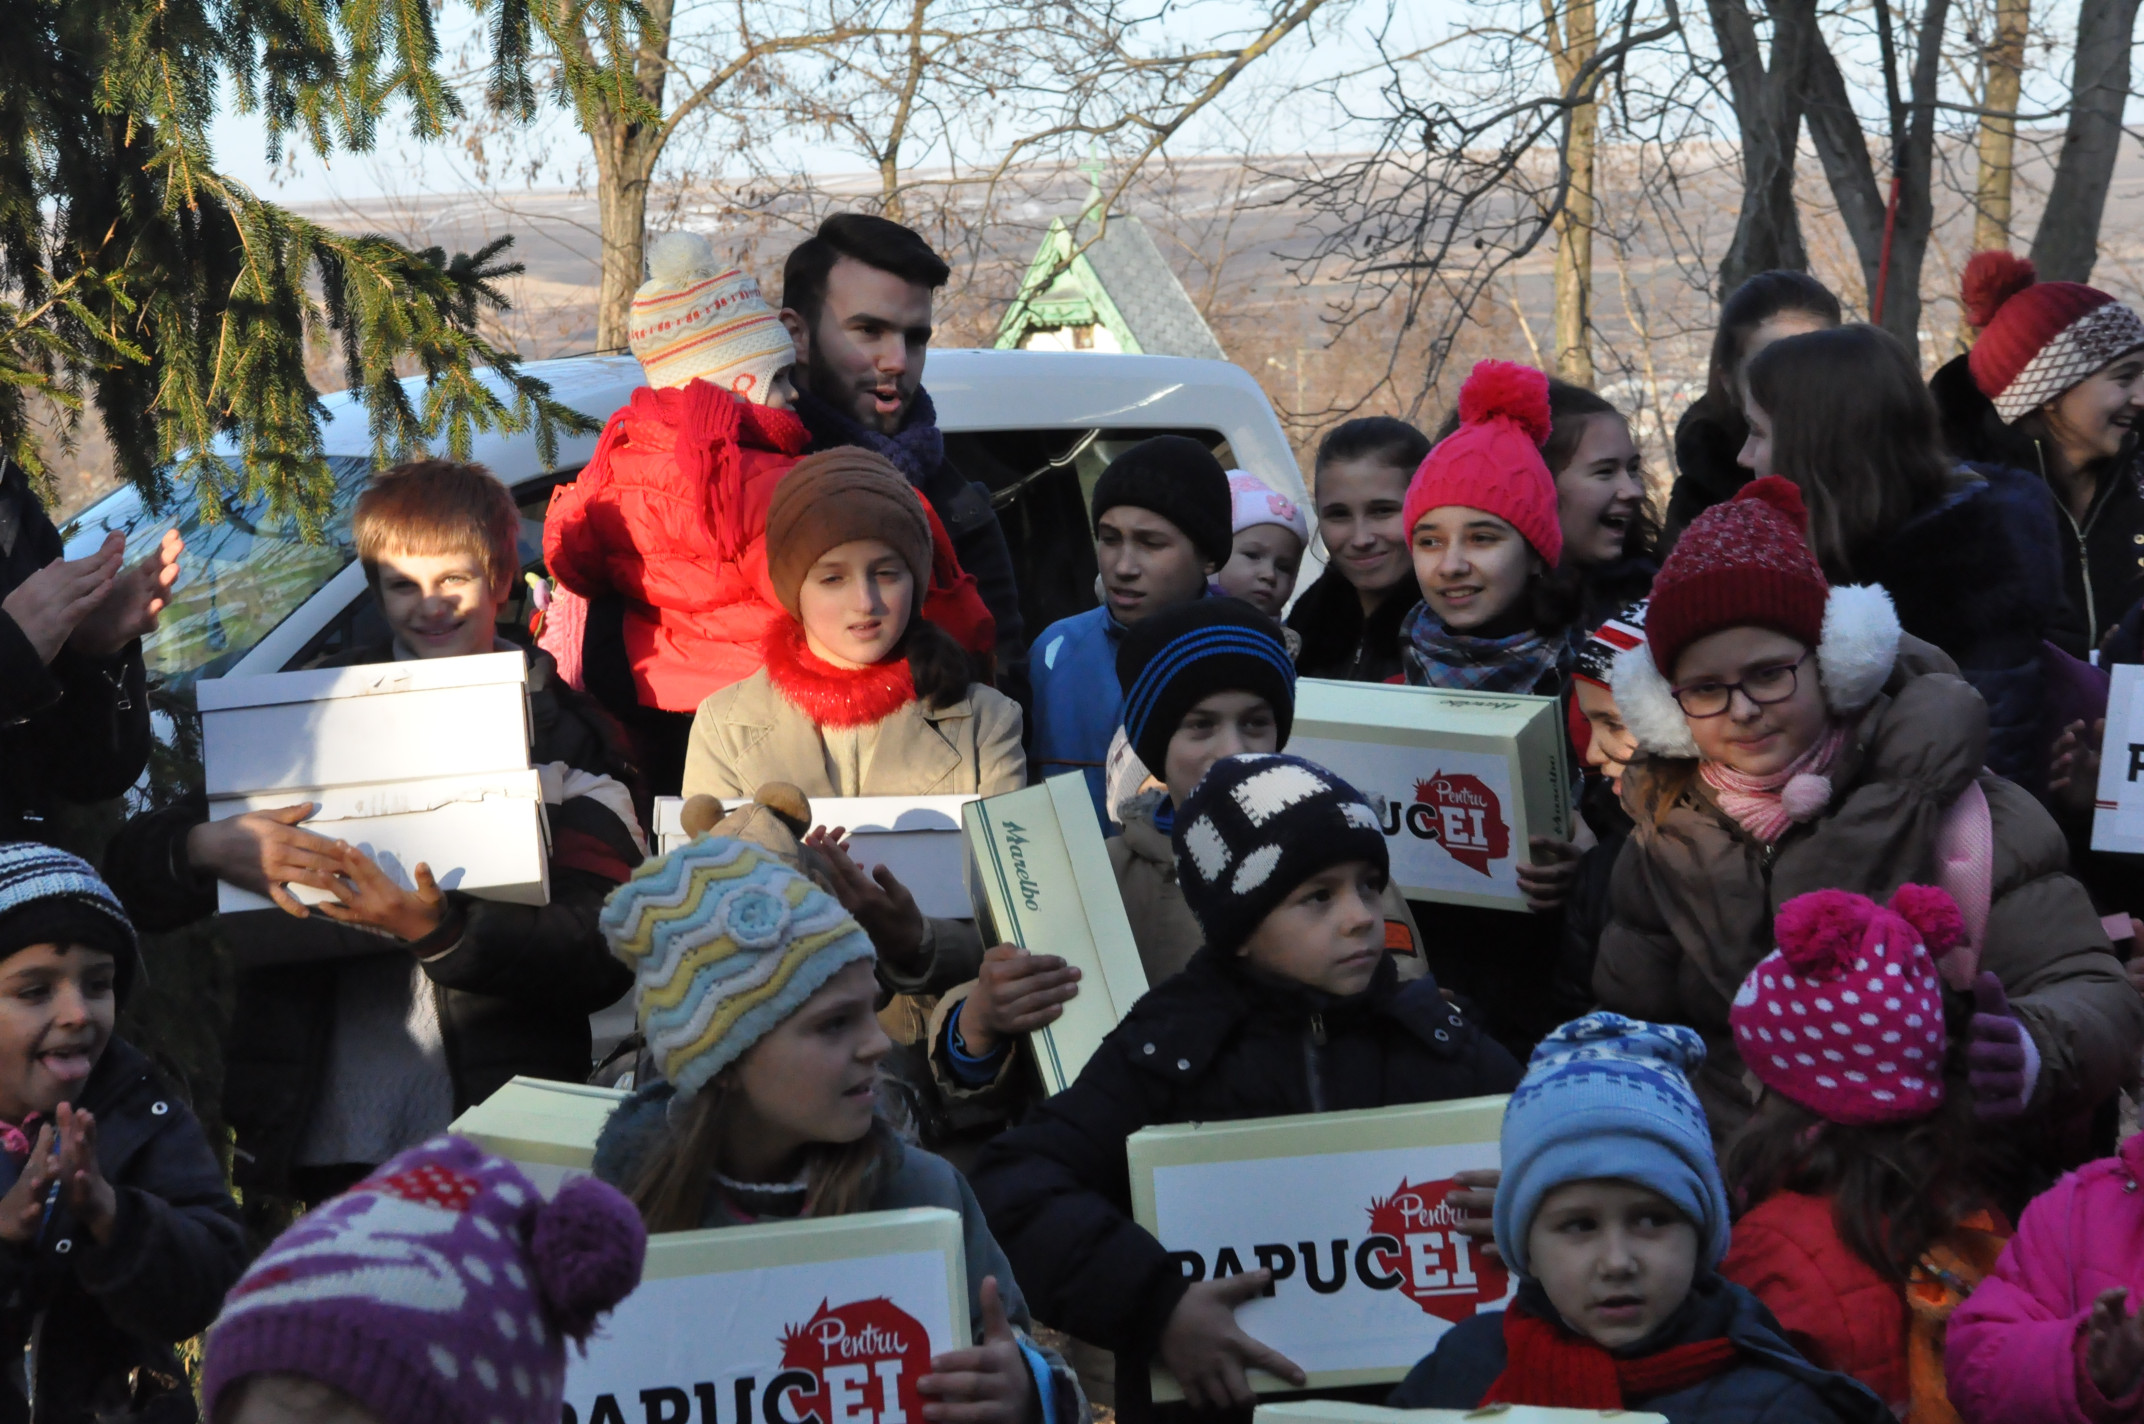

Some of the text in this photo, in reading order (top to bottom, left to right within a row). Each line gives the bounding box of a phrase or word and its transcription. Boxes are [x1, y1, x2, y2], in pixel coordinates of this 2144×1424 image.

[1431, 780, 1488, 807] Pentru
[1381, 801, 1488, 846] UCEI
[1001, 820, 1040, 912] Marelbo
[809, 1317, 909, 1361] Pentru
[562, 1359, 908, 1424] APUCEI
